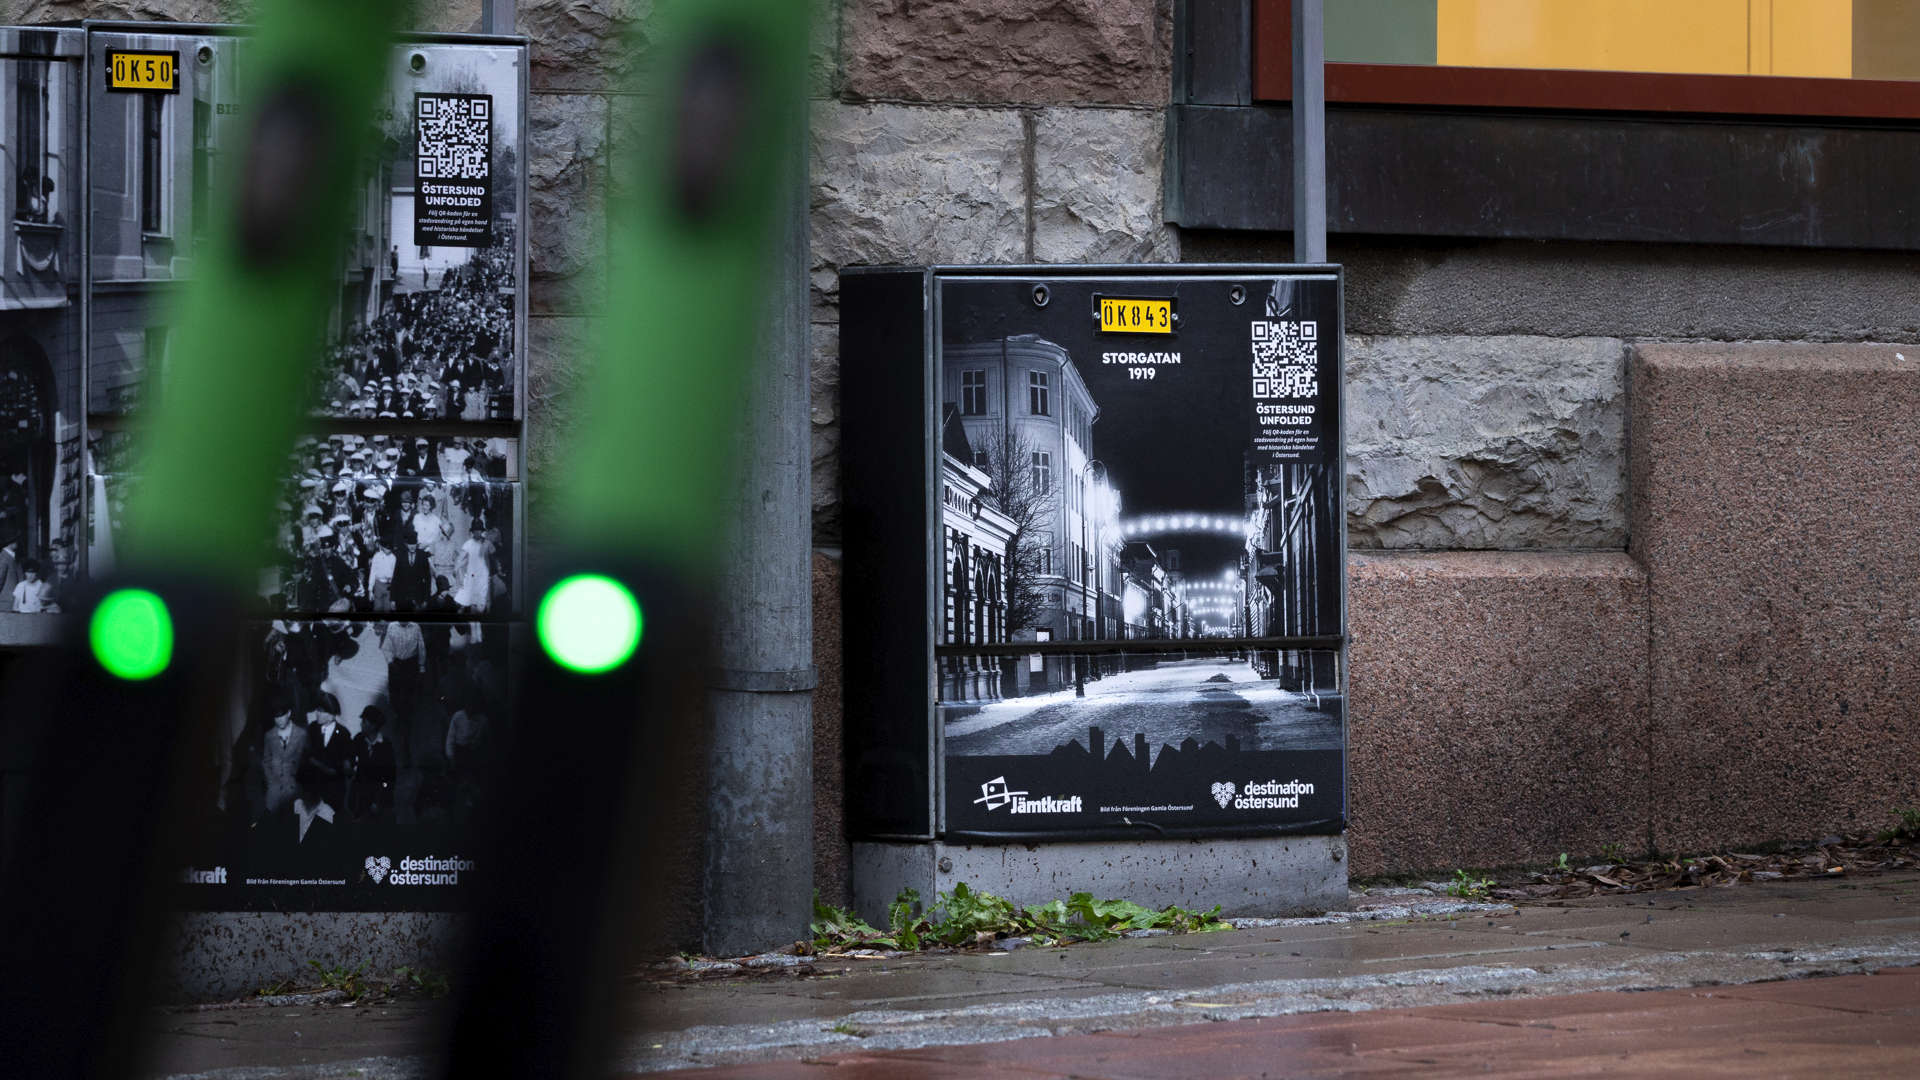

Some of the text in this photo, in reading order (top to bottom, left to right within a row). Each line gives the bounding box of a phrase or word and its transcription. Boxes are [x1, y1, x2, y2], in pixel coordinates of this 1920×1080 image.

[115, 55, 170, 83] ÖK50
[421, 181, 485, 196] ÖSTERSUND
[425, 196, 482, 206] UNFOLDED
[428, 209, 438, 217] Följ
[462, 210, 471, 218] för
[418, 218, 454, 226] stadsvandring
[454, 218, 461, 226] på
[1104, 300, 1168, 328] ÖK843
[1102, 352, 1181, 364] STORGATAN
[1128, 367, 1156, 380] 1919
[1256, 402, 1315, 414] ÖSTERSUND
[1260, 416, 1312, 425] UNFOLDED
[1287, 436, 1294, 444] på
[1244, 778, 1314, 795] destination
[1010, 796, 1083, 814] Jämtkraft
[1234, 793, 1299, 809] östersund
[1122, 805, 1150, 813] Föreningen
[1167, 803, 1194, 811] Östersund
[400, 854, 474, 871] destination
[269, 878, 300, 886] Föreningen
[318, 877, 346, 885] Östersund
[389, 869, 458, 885] östersund
